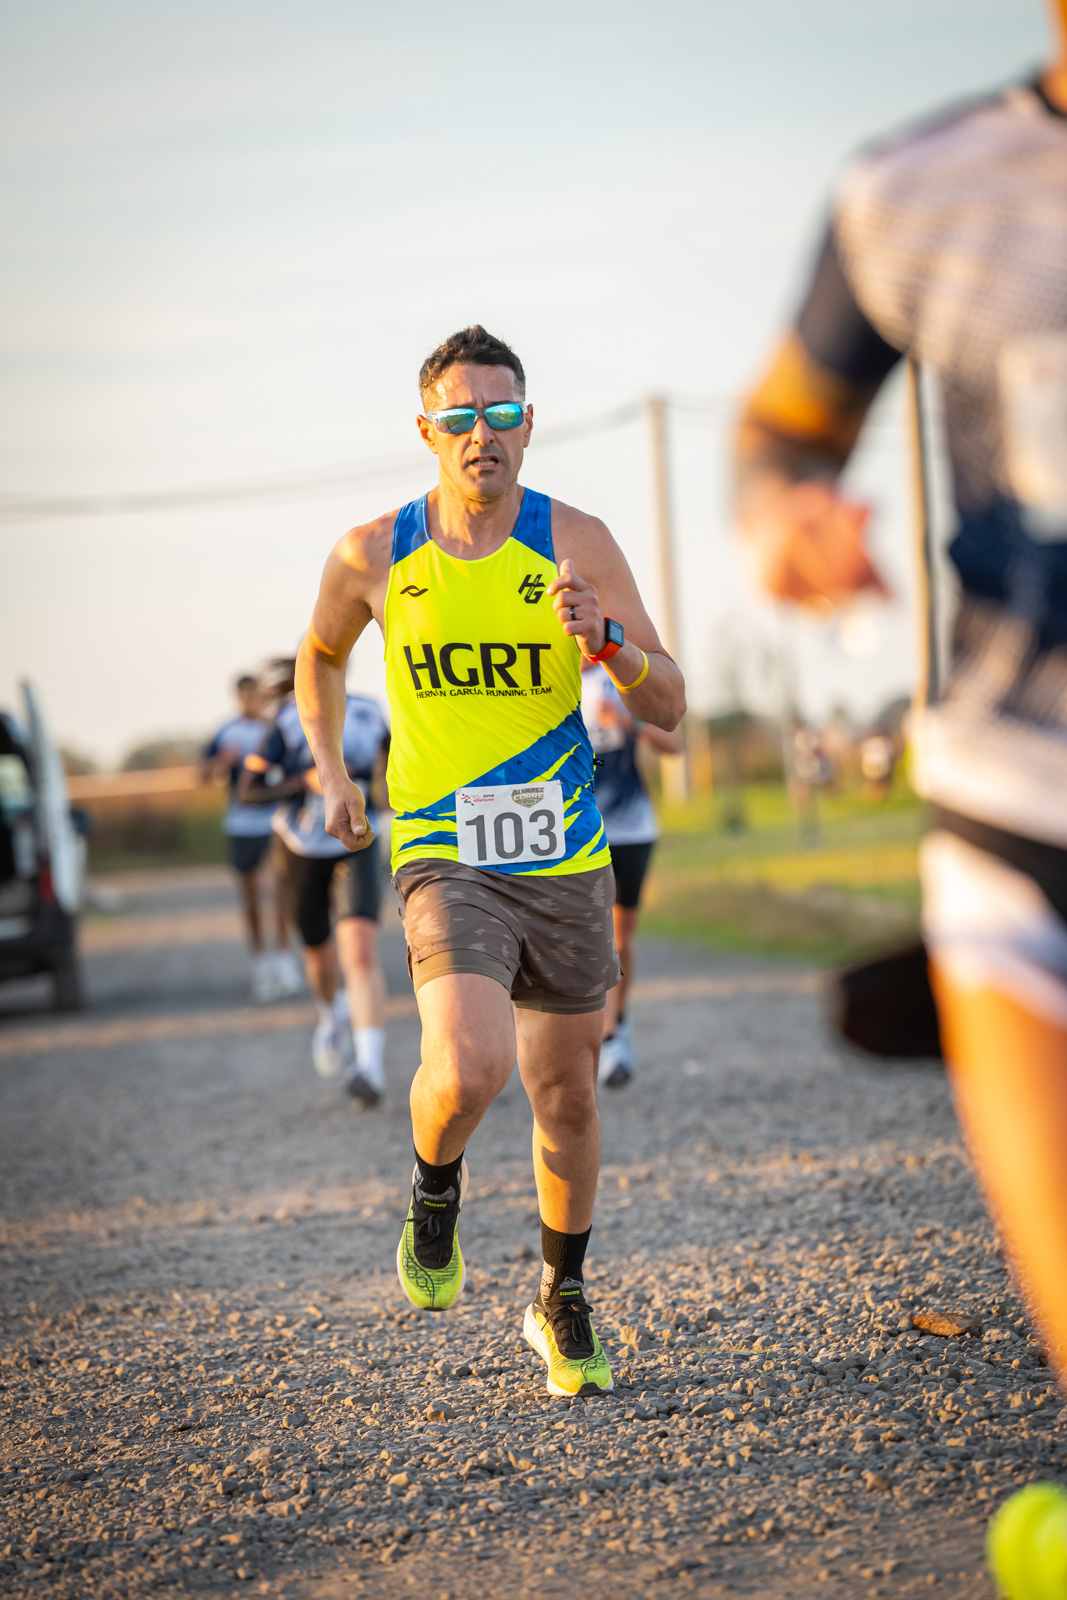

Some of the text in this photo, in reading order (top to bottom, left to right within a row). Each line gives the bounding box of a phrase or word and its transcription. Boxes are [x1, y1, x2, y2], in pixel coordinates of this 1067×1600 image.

[403, 643, 552, 690] HGRT
[485, 689, 528, 697] RUNNING
[529, 686, 553, 696] TEAM
[512, 787, 545, 795] ALVAREZ
[513, 792, 545, 801] CORRE
[465, 809, 557, 861] 103
